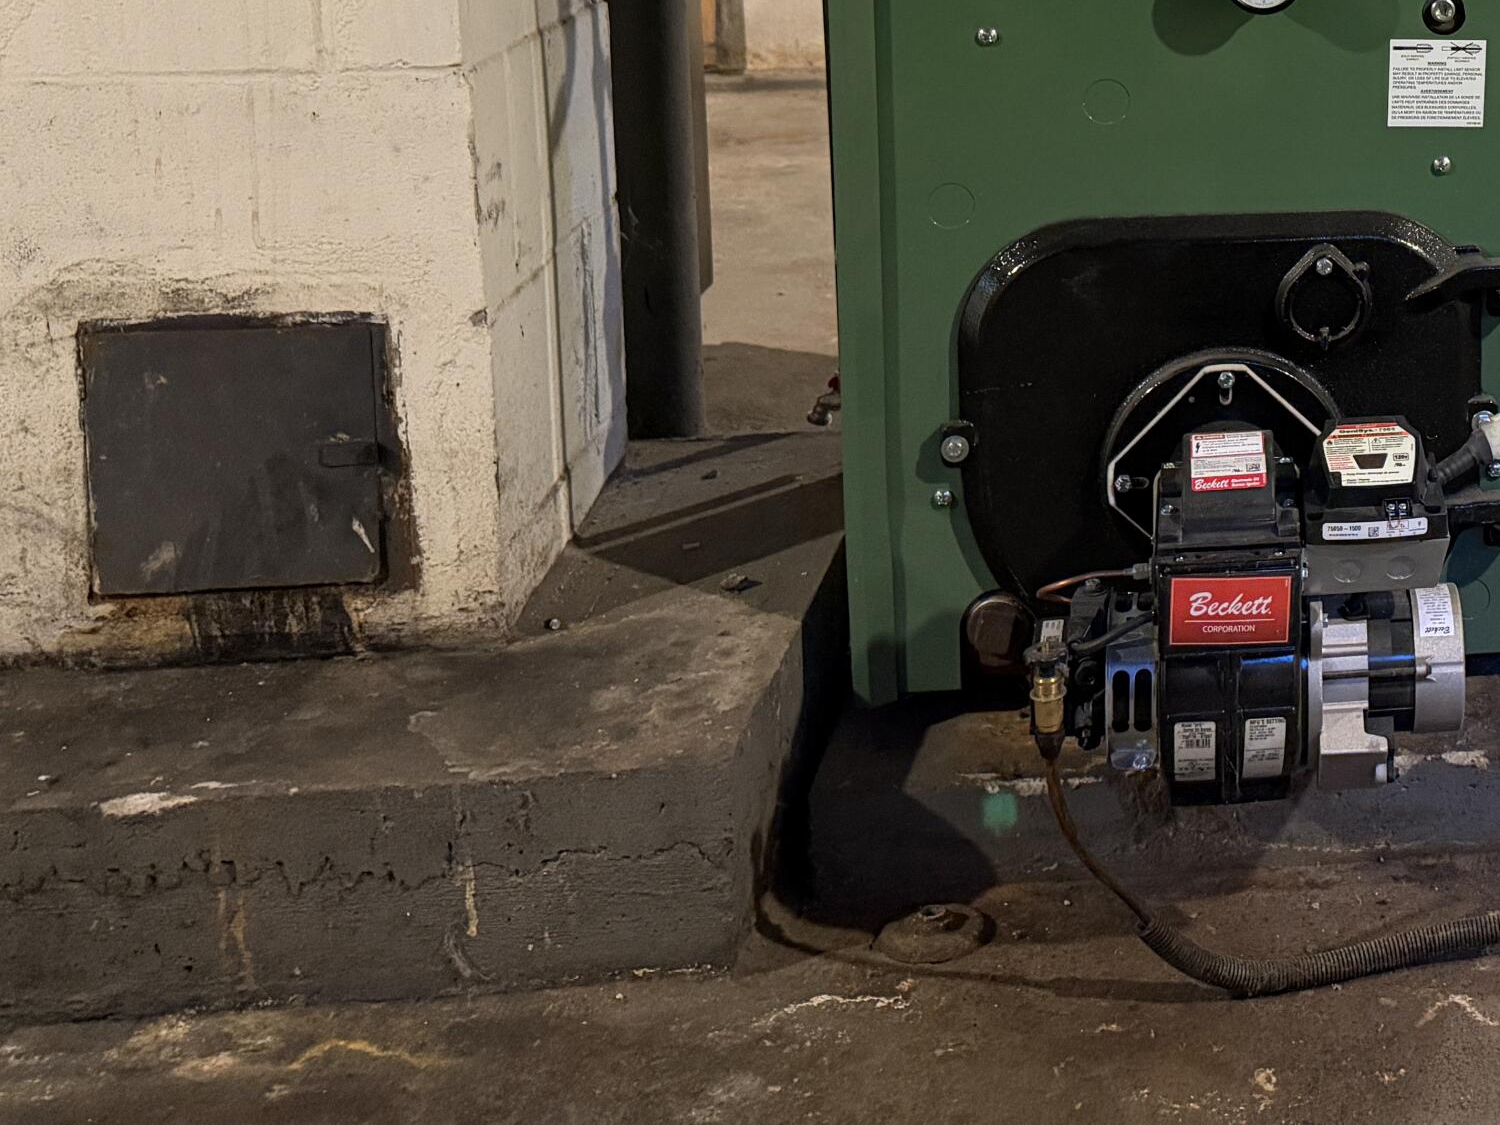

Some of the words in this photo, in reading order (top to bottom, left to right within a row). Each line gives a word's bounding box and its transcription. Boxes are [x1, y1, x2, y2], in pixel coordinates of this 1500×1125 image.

[1194, 478, 1229, 490] Beckett
[1189, 591, 1272, 616] Beckett
[1202, 624, 1255, 633] CORPORATION
[1425, 626, 1450, 634] Beckett
